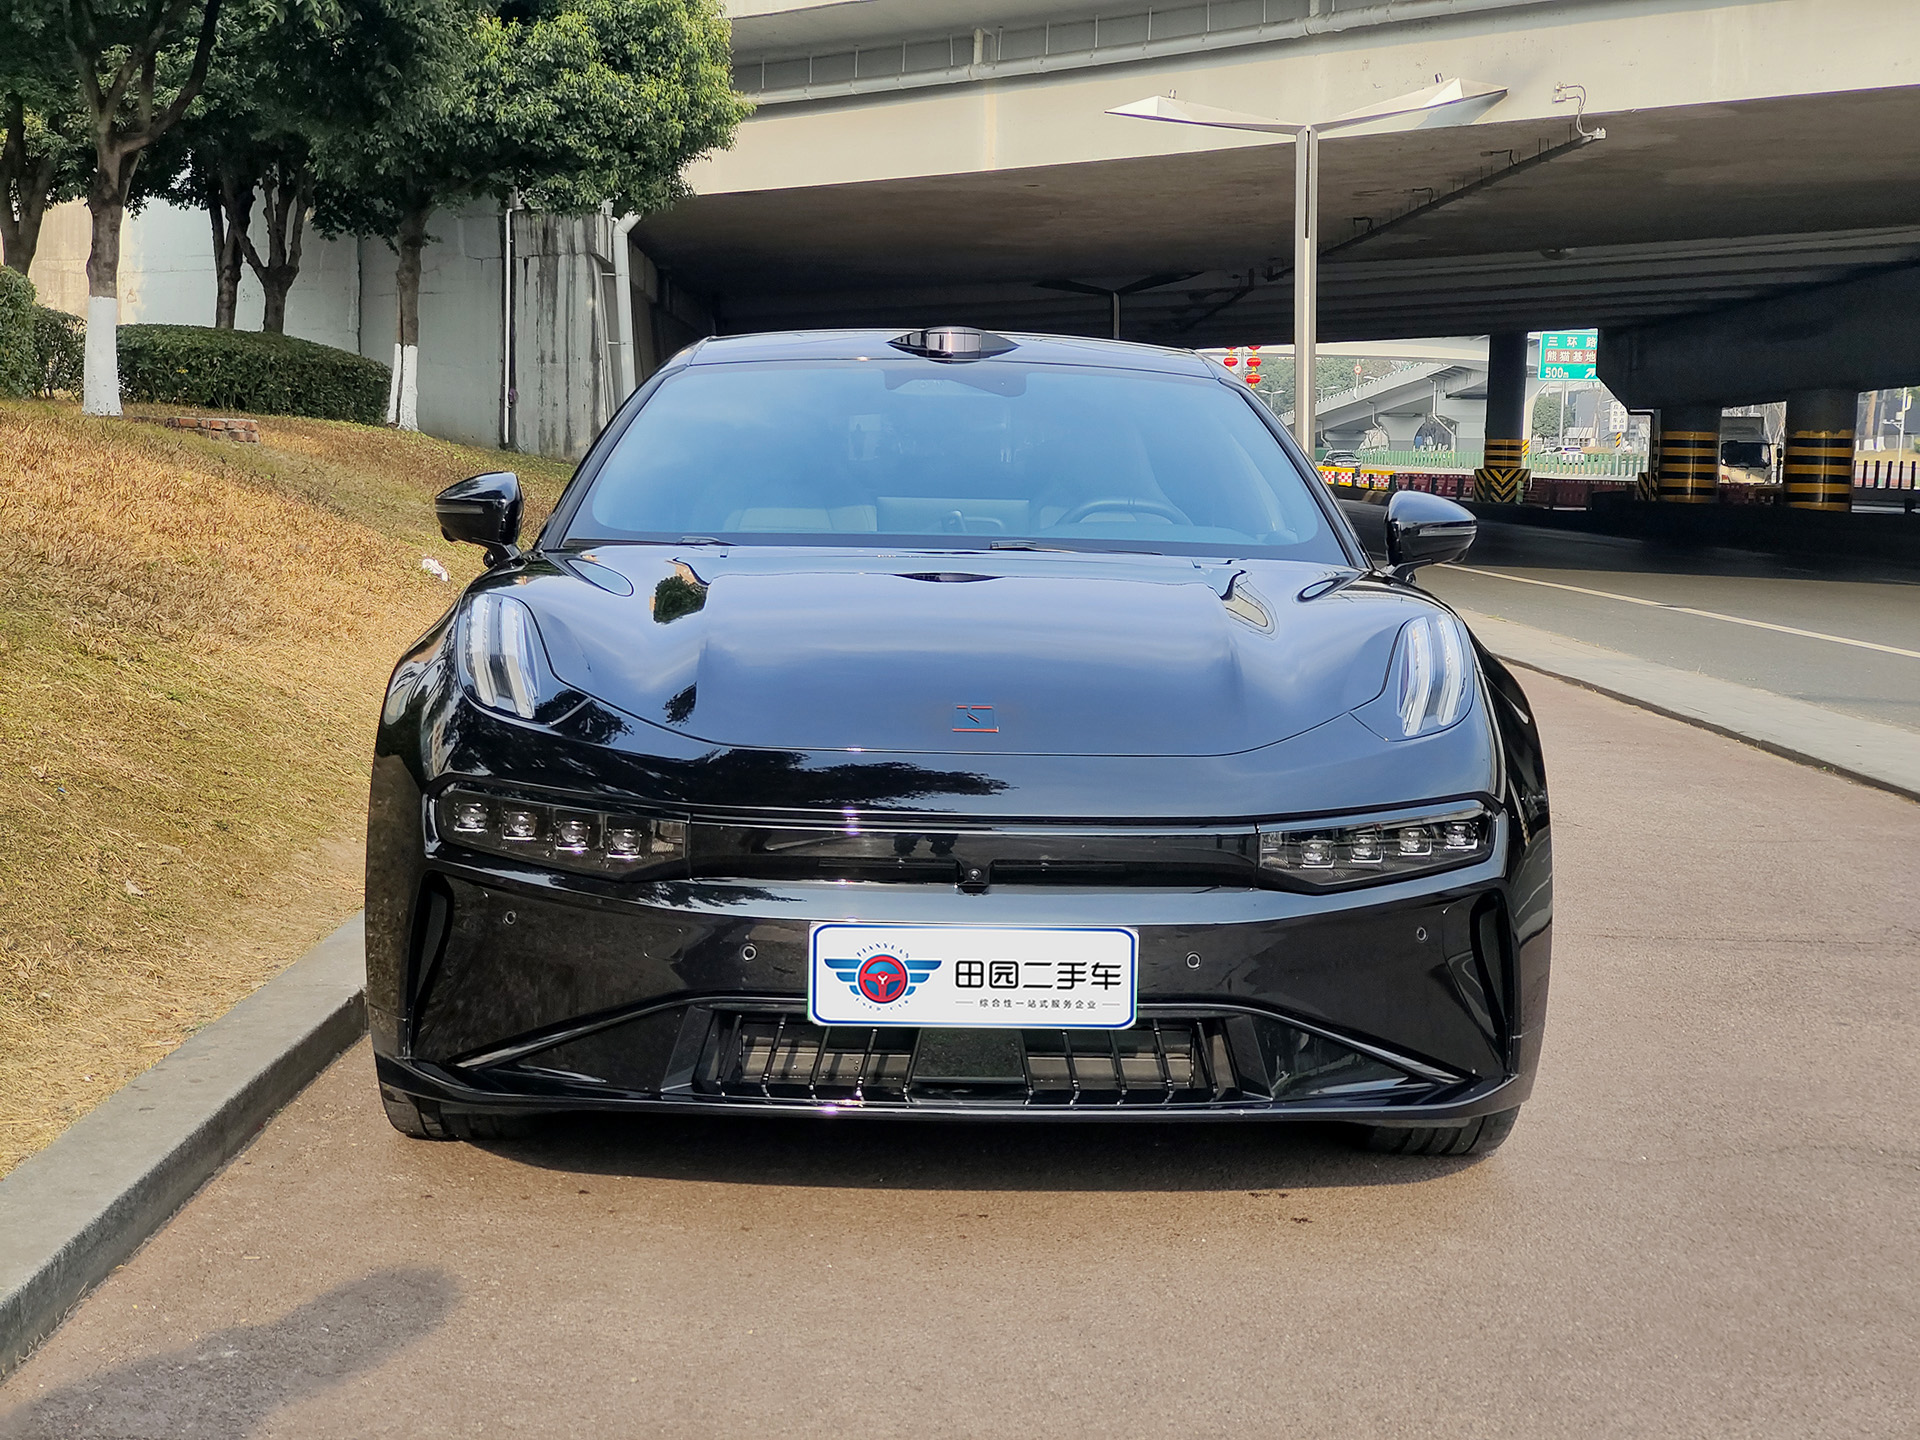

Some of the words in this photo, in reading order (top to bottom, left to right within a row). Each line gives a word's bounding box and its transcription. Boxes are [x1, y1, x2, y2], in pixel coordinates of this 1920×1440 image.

[1547, 336, 1598, 348] 三环路
[1546, 350, 1597, 362] 熊猫基地
[1545, 367, 1569, 379] 500m
[877, 975, 888, 985] Y
[955, 959, 1122, 991] 田园二手车
[978, 998, 1097, 1010] 综合性一站式服务企业
